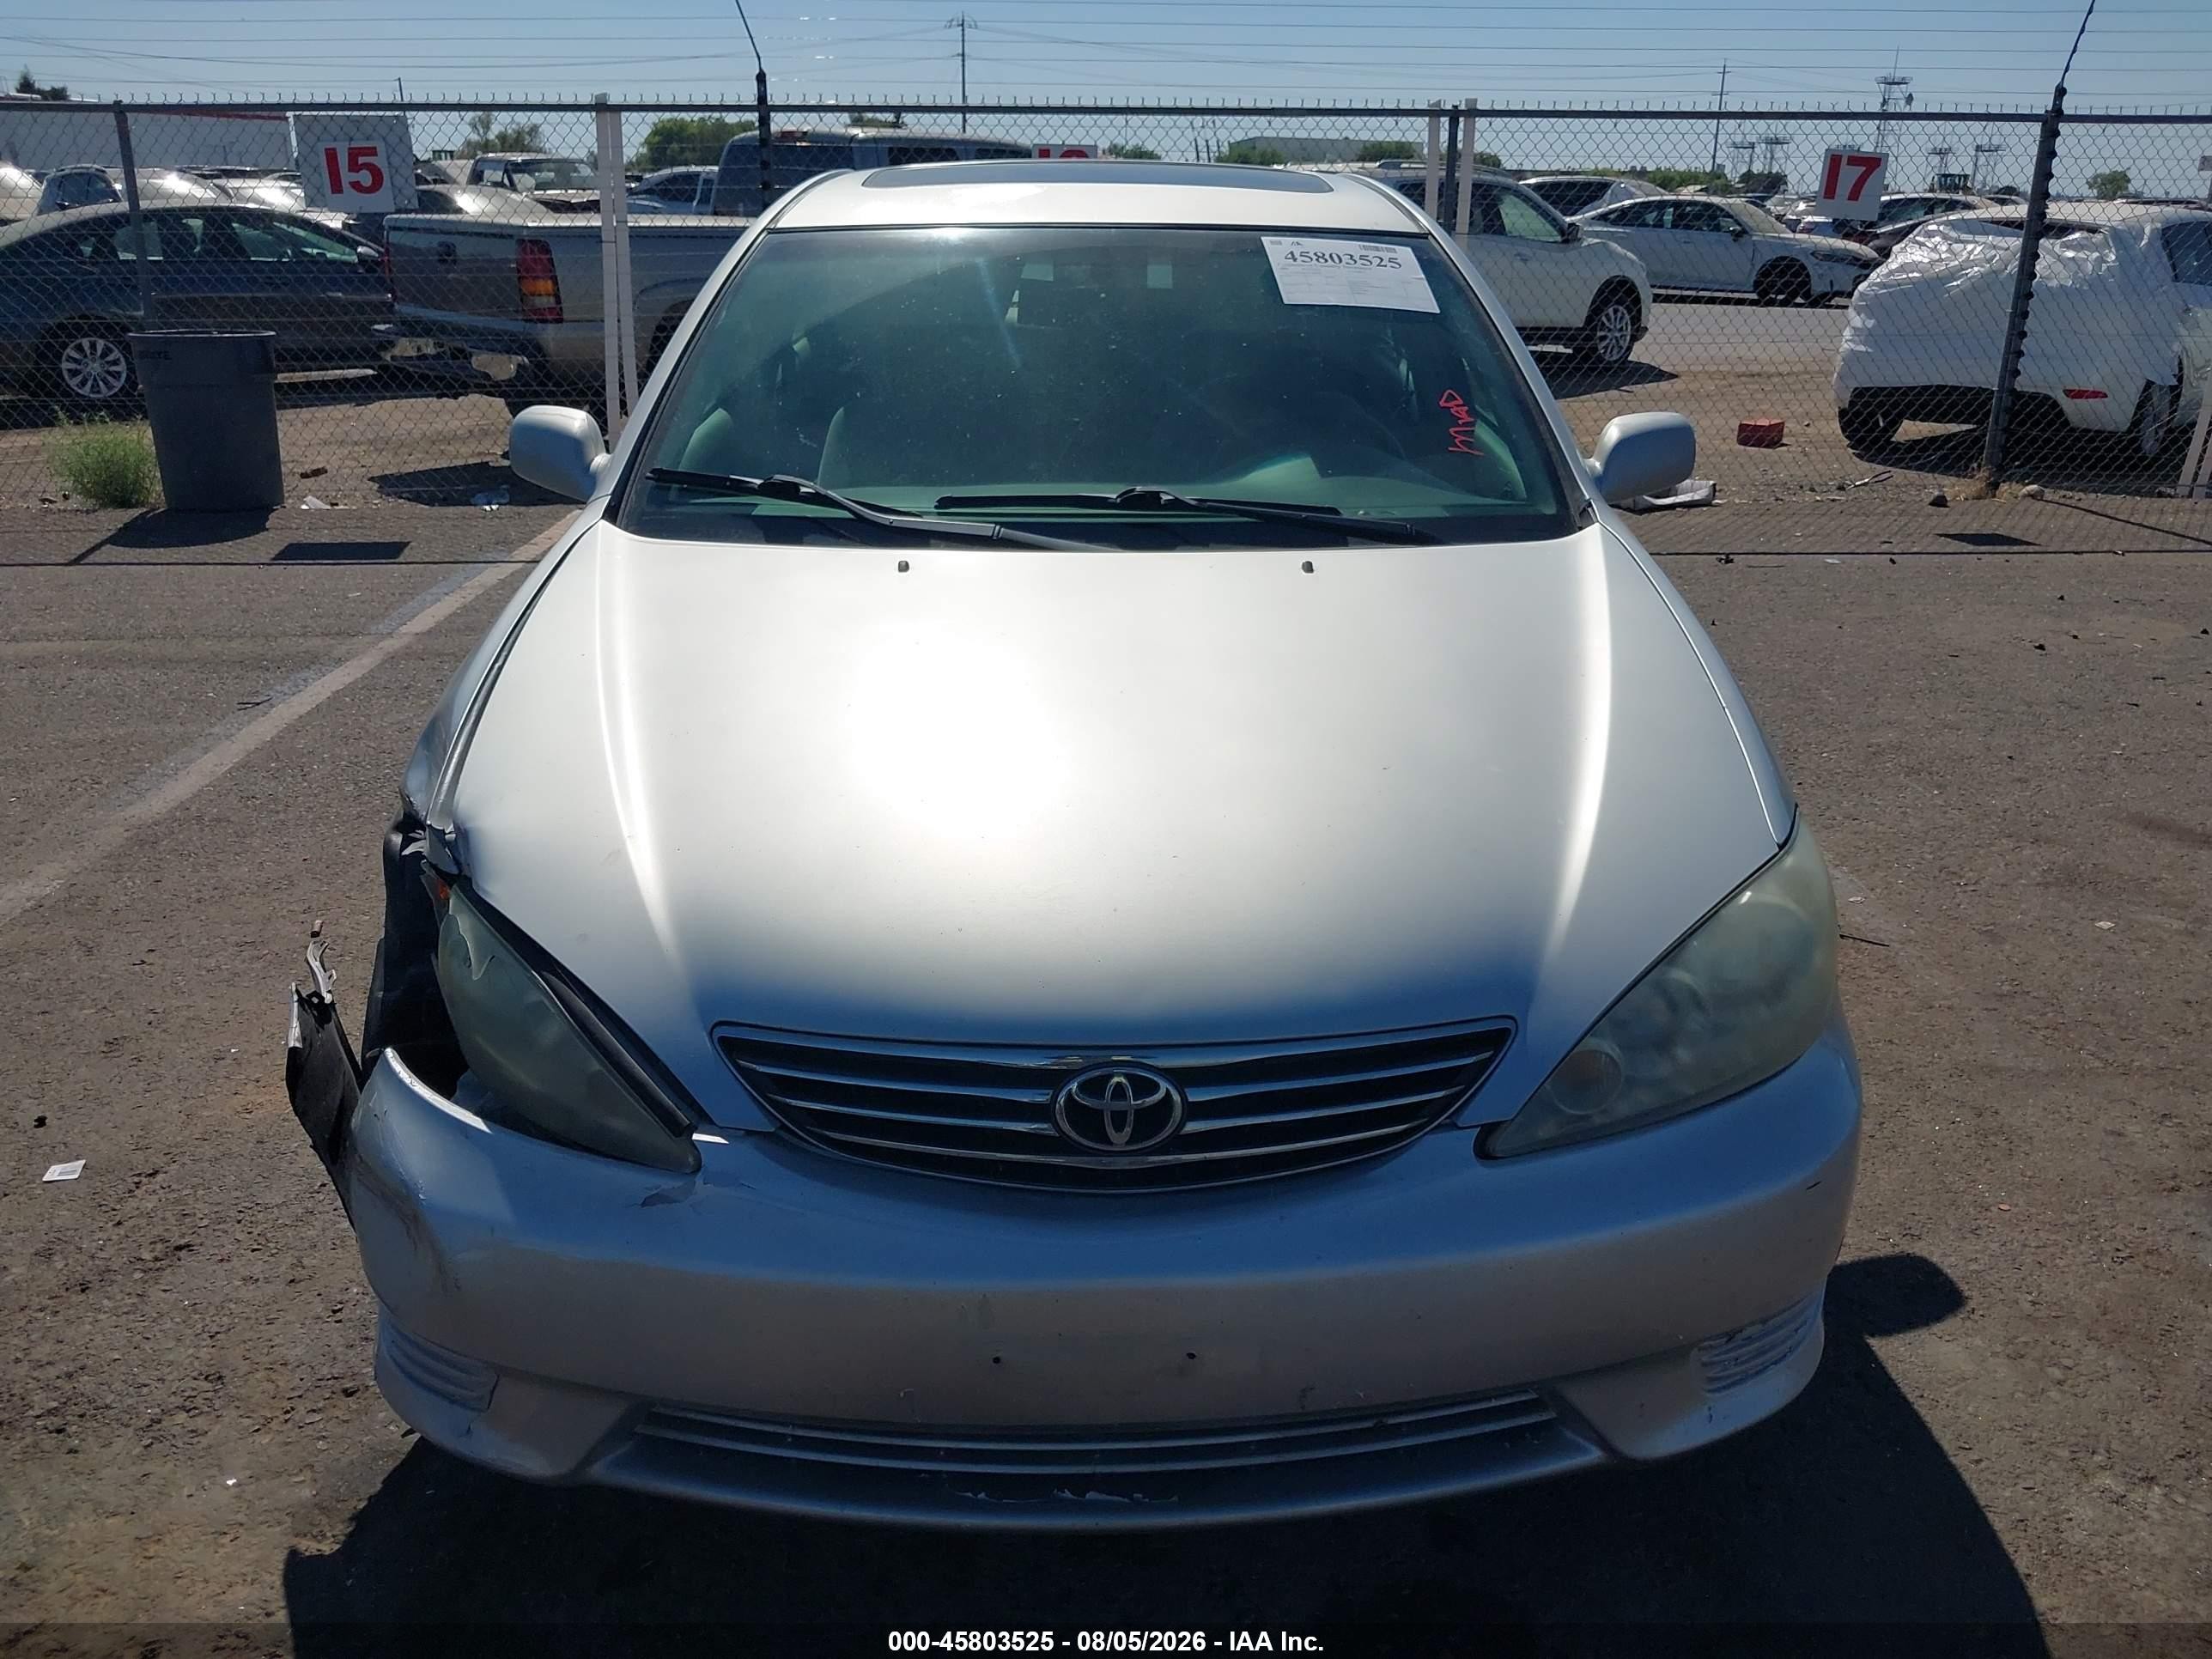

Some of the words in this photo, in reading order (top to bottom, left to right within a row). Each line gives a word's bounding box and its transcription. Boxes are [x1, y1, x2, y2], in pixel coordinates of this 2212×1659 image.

[324, 146, 385, 195] 15
[1823, 154, 1882, 202] 17
[1284, 250, 1402, 270] 45803525
